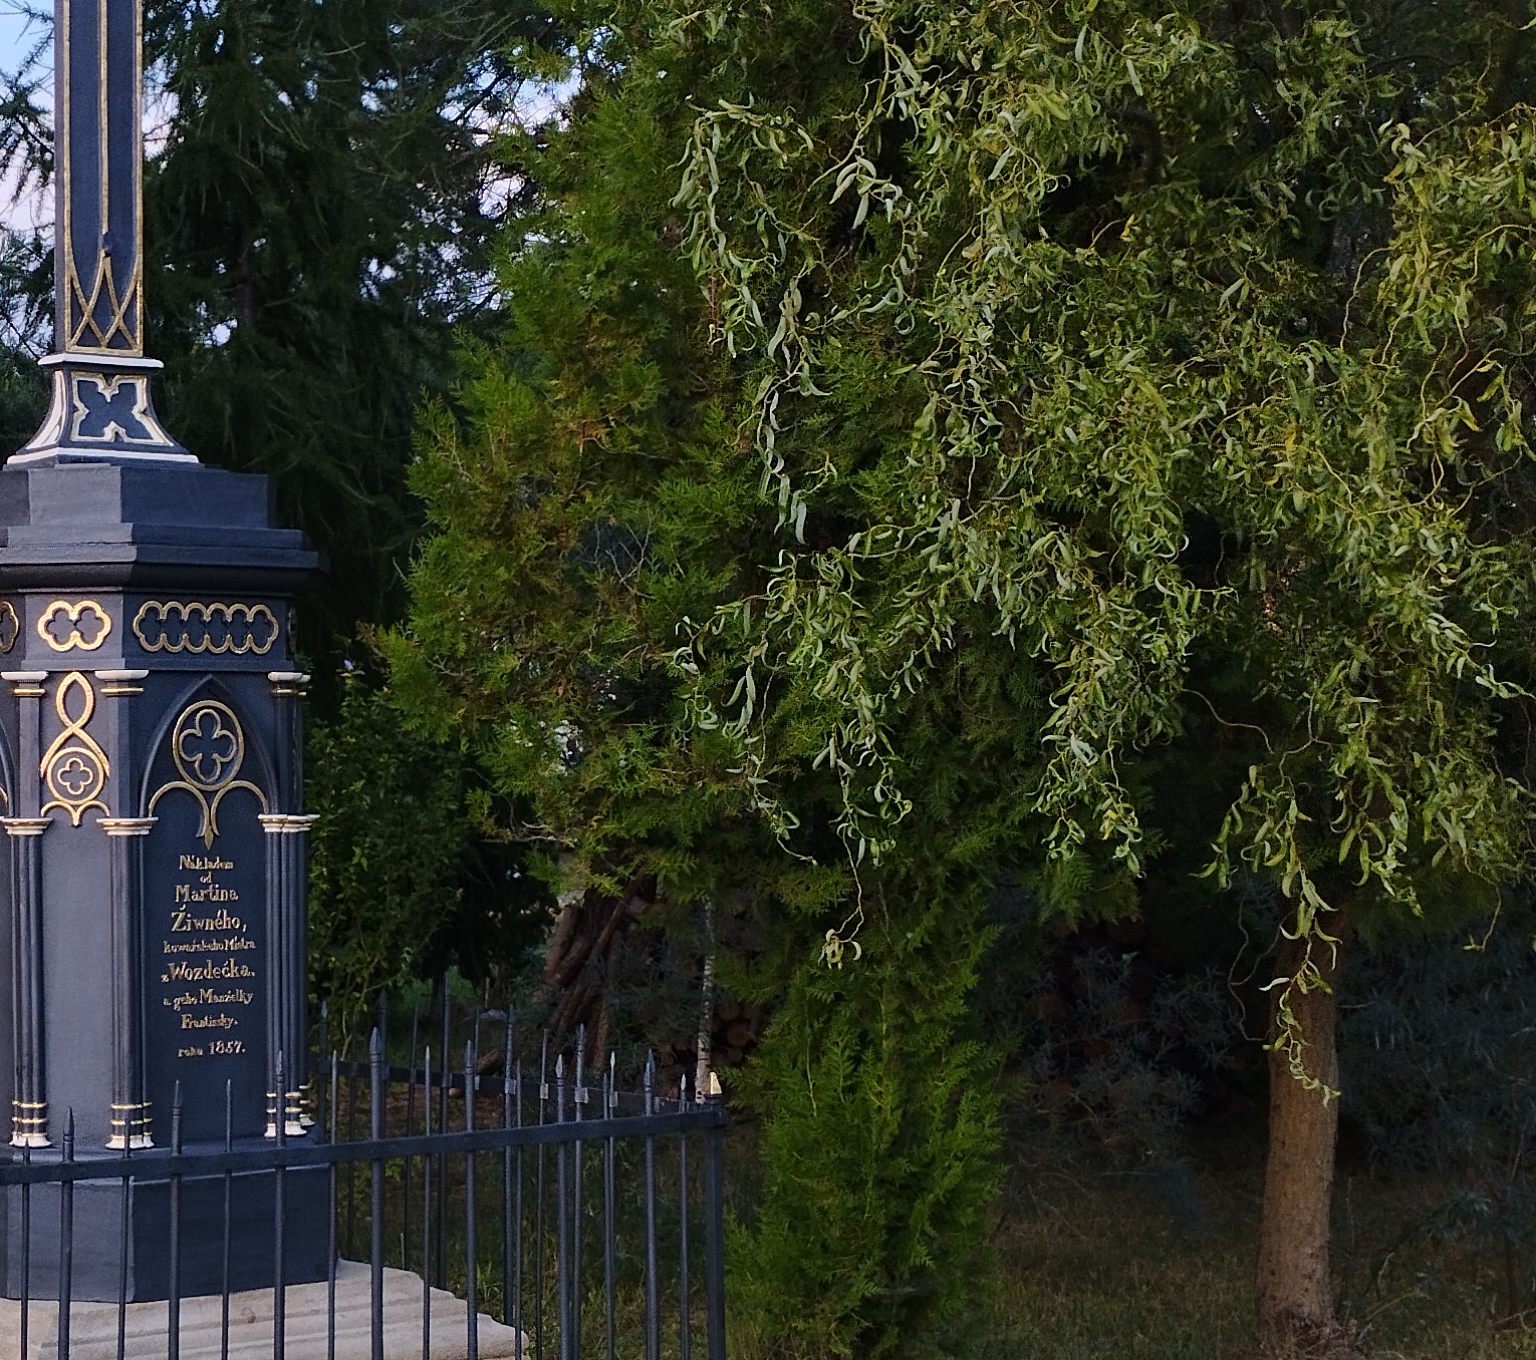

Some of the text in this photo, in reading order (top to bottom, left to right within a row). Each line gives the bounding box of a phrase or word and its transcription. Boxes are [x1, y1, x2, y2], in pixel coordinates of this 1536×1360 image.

[199, 871, 213, 883] od
[174, 883, 239, 903] Martina
[208, 1039, 246, 1055] 1857.
